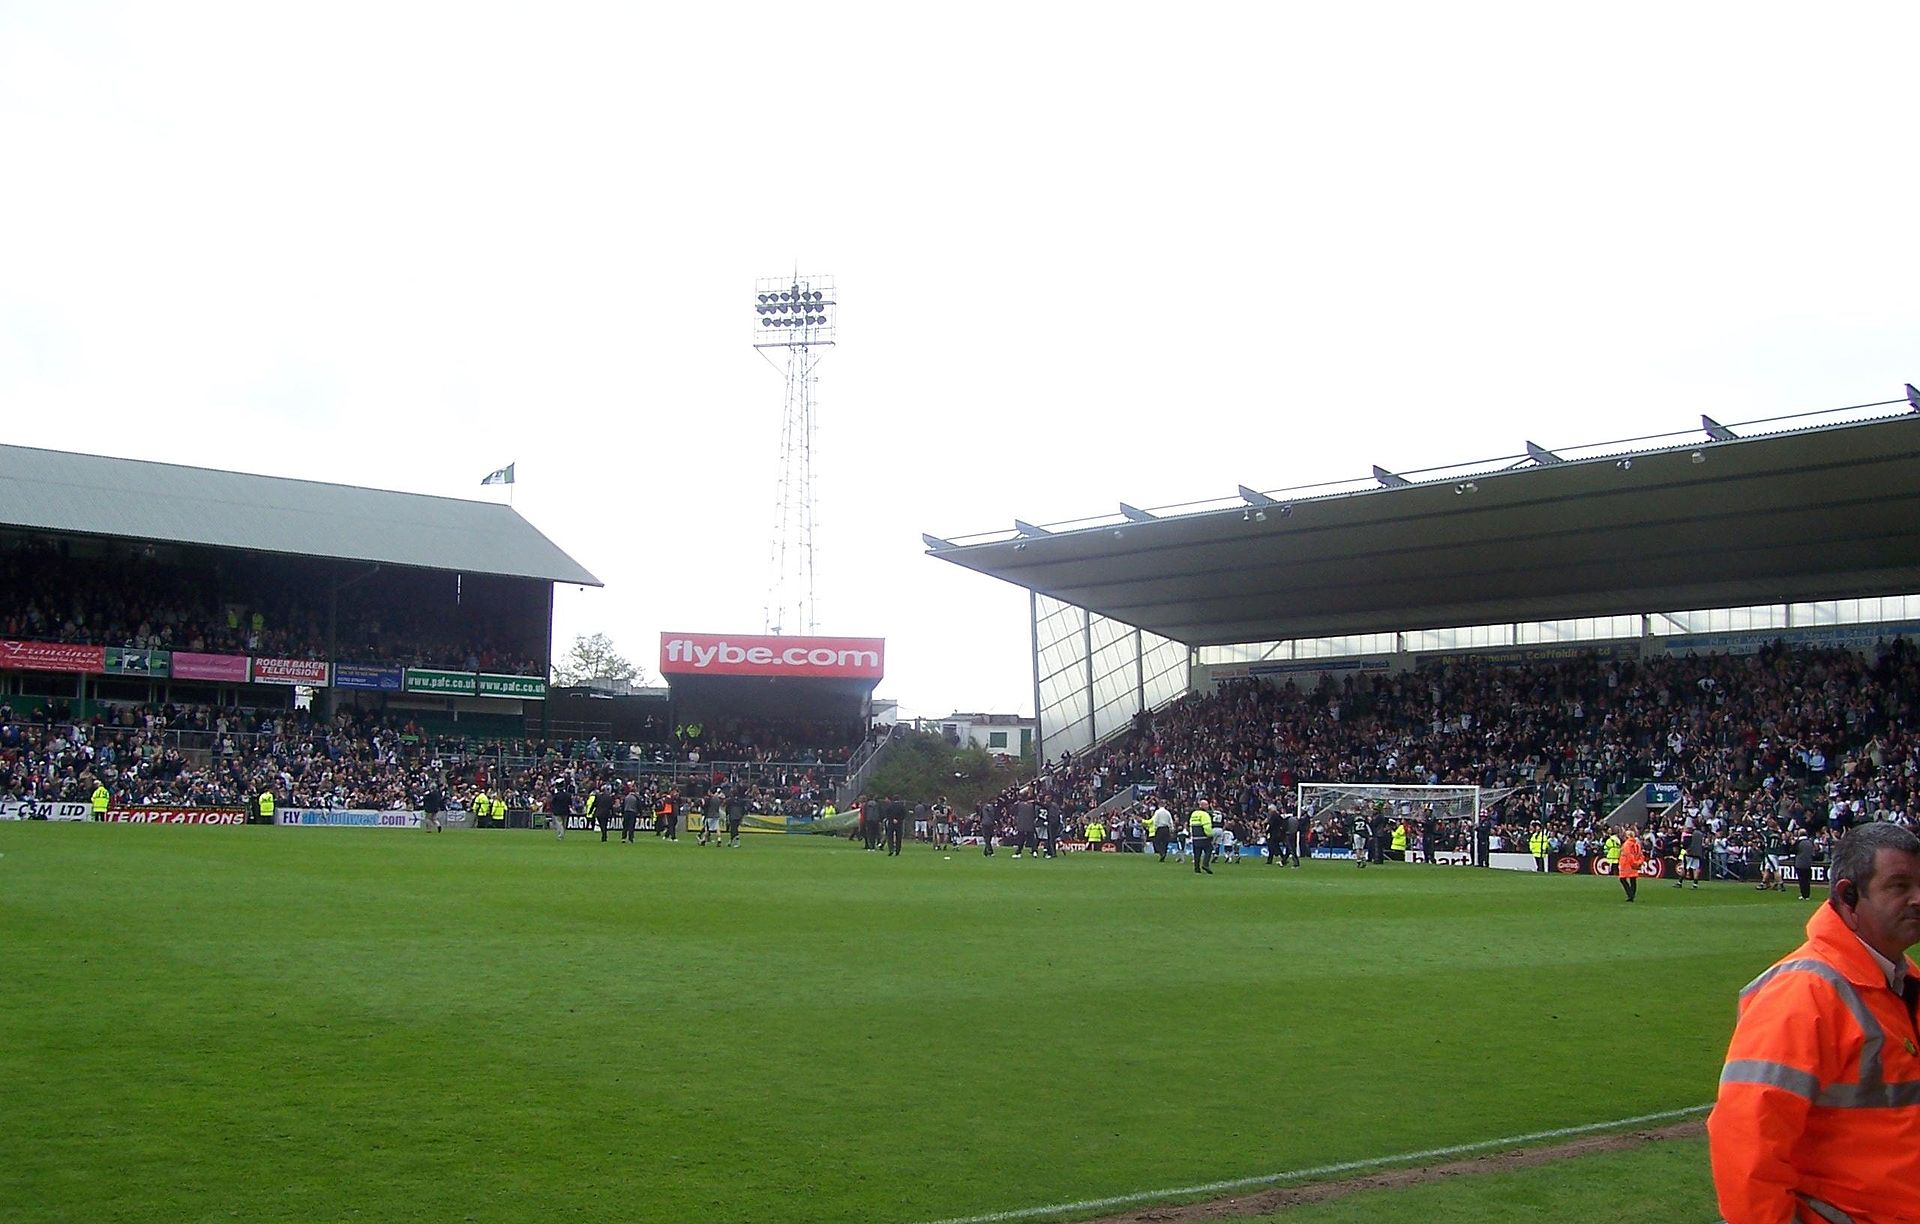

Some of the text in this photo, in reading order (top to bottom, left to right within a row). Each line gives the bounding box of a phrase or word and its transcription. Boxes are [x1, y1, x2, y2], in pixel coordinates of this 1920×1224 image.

[665, 640, 878, 667] flybe.com
[256, 658, 325, 670] ROGER BAKER
[262, 666, 319, 677] TELEVISION
[408, 677, 476, 689] www.pafc.co.uk
[480, 681, 546, 693] www.pafc.co.uk
[1656, 793, 1664, 802] 3
[60, 805, 85, 816] LTD
[107, 811, 244, 825] TEMPTATIONS
[283, 811, 299, 824] FLY
[1354, 821, 1366, 831] 22
